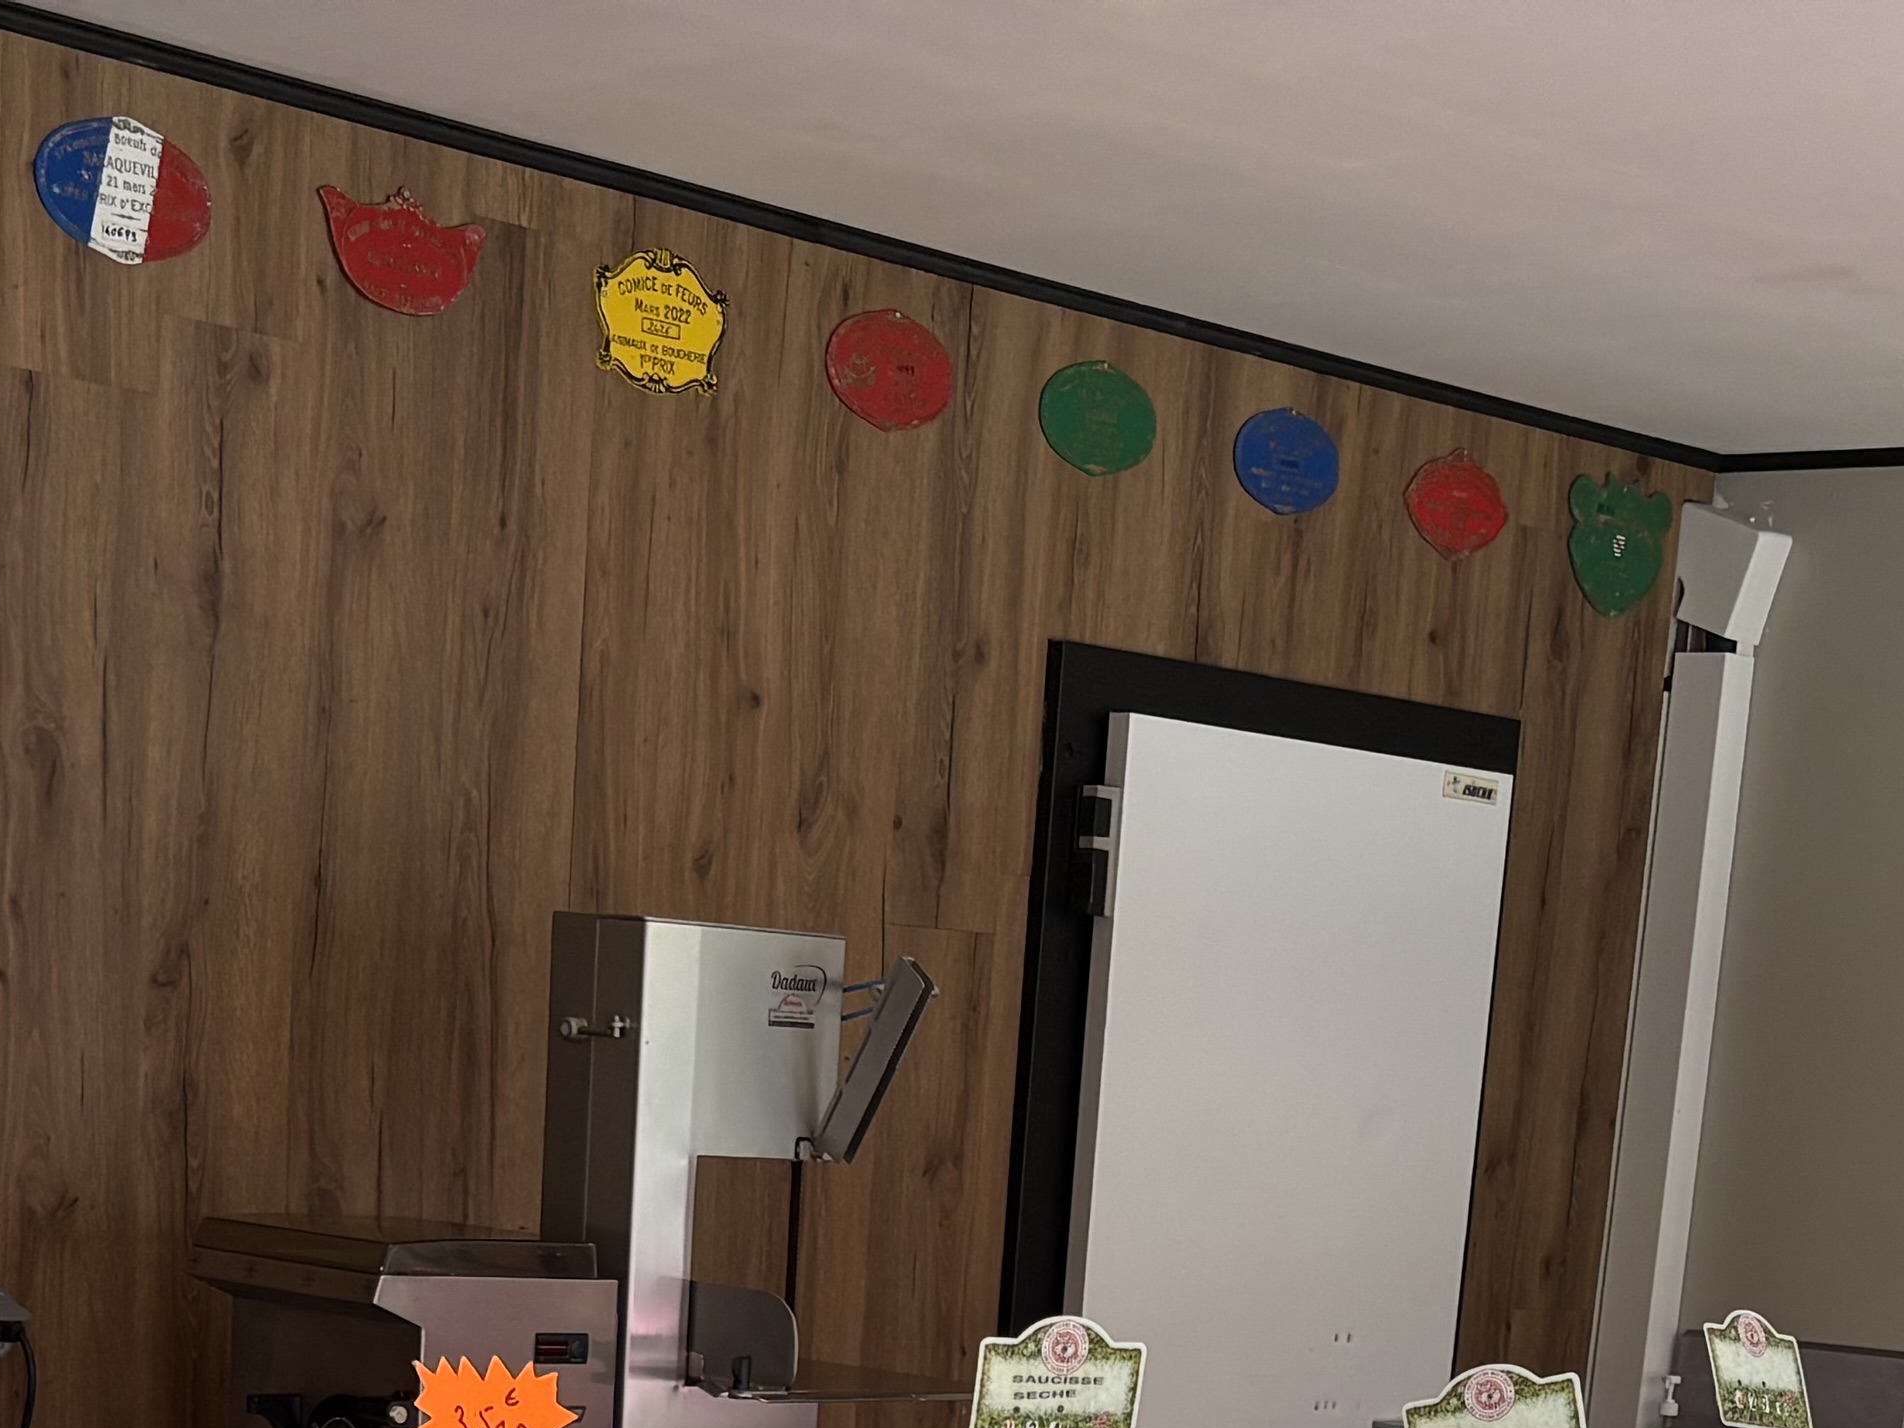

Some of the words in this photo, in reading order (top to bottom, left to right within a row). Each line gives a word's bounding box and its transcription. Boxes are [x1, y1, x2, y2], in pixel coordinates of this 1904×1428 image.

[618, 276, 659, 296] COMICE
[676, 284, 709, 316] FEURS
[664, 305, 692, 325] 2022
[662, 345, 707, 365] BOUCHERIE
[652, 357, 675, 376] PRIX
[1012, 1375, 1105, 1386] SAUCISSE
[1013, 1389, 1077, 1401] SECHE
